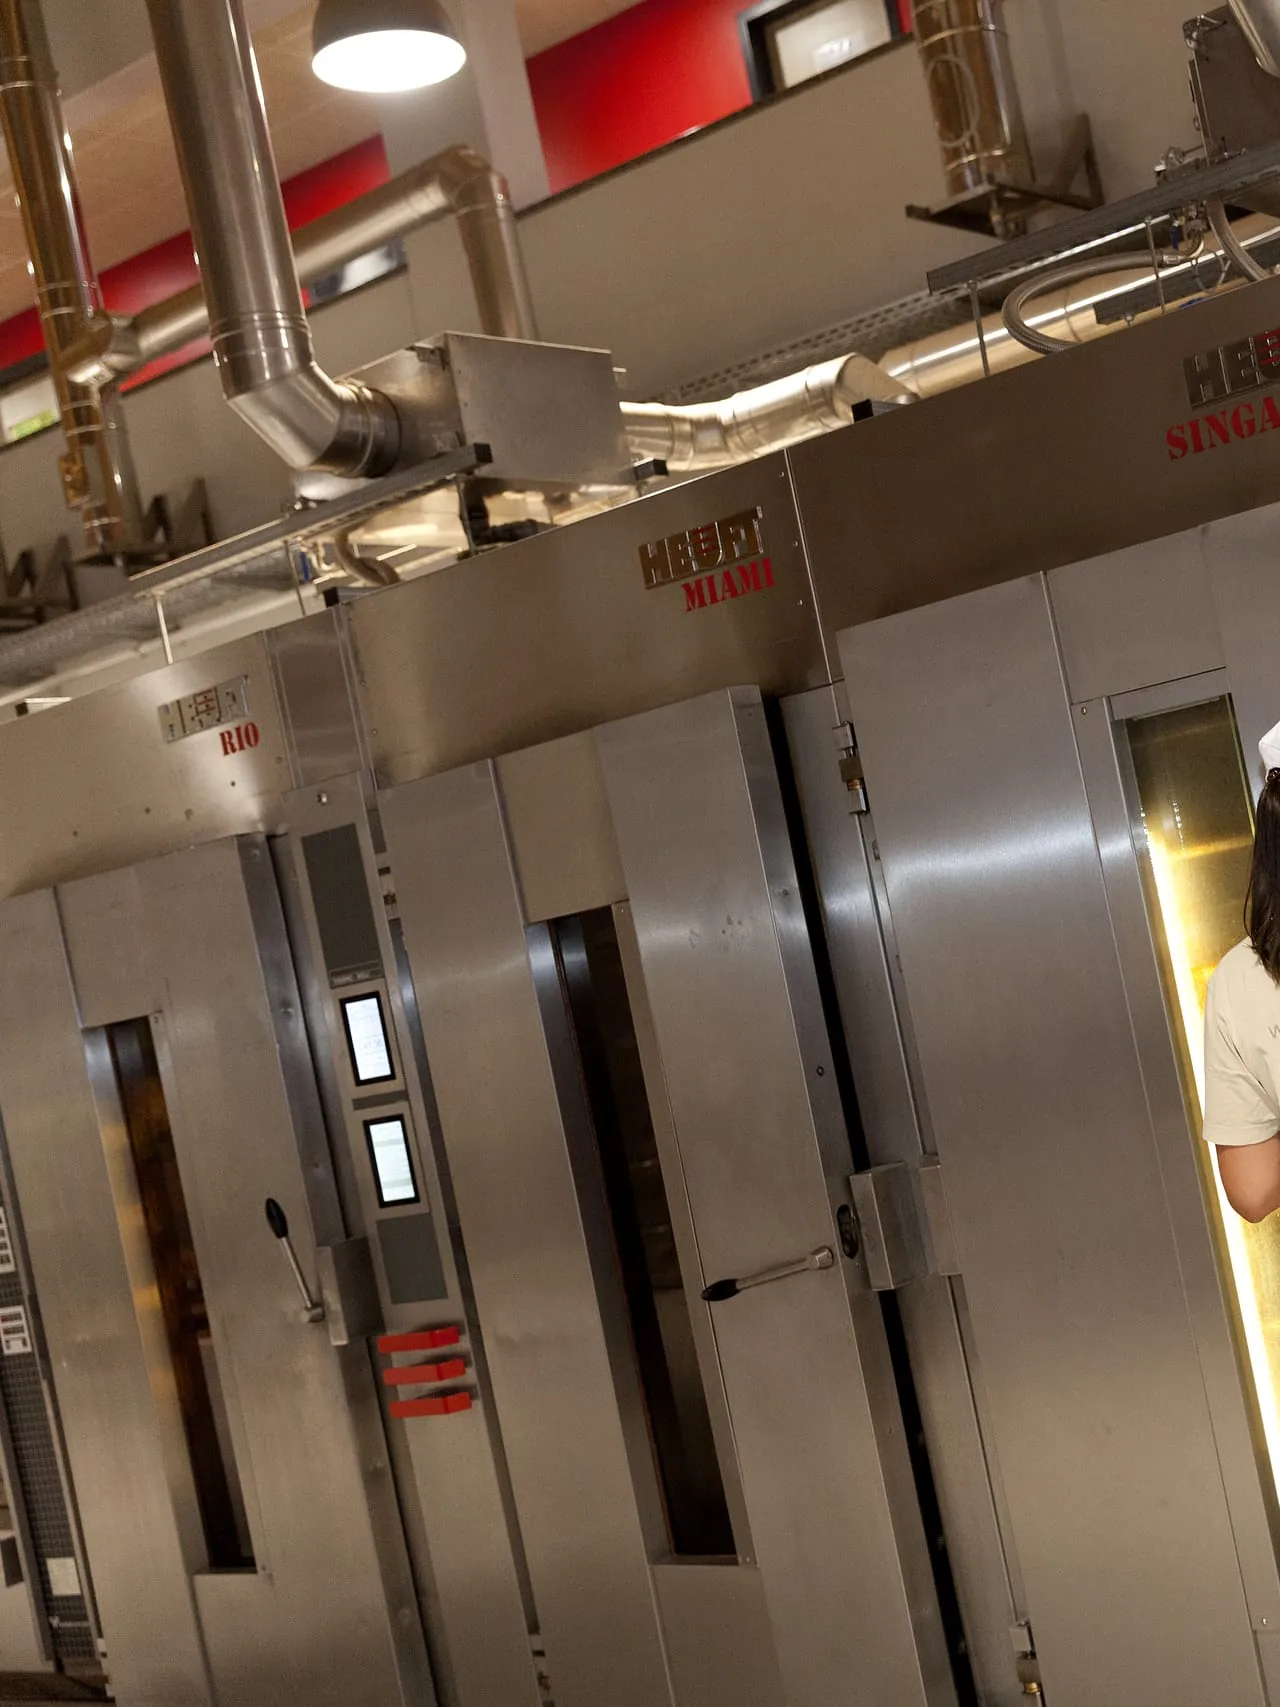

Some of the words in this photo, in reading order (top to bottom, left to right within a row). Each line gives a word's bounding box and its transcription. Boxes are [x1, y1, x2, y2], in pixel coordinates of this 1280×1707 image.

[638, 506, 763, 589] HEUFT
[681, 557, 776, 612] MIAMI
[219, 722, 259, 756] RIO
